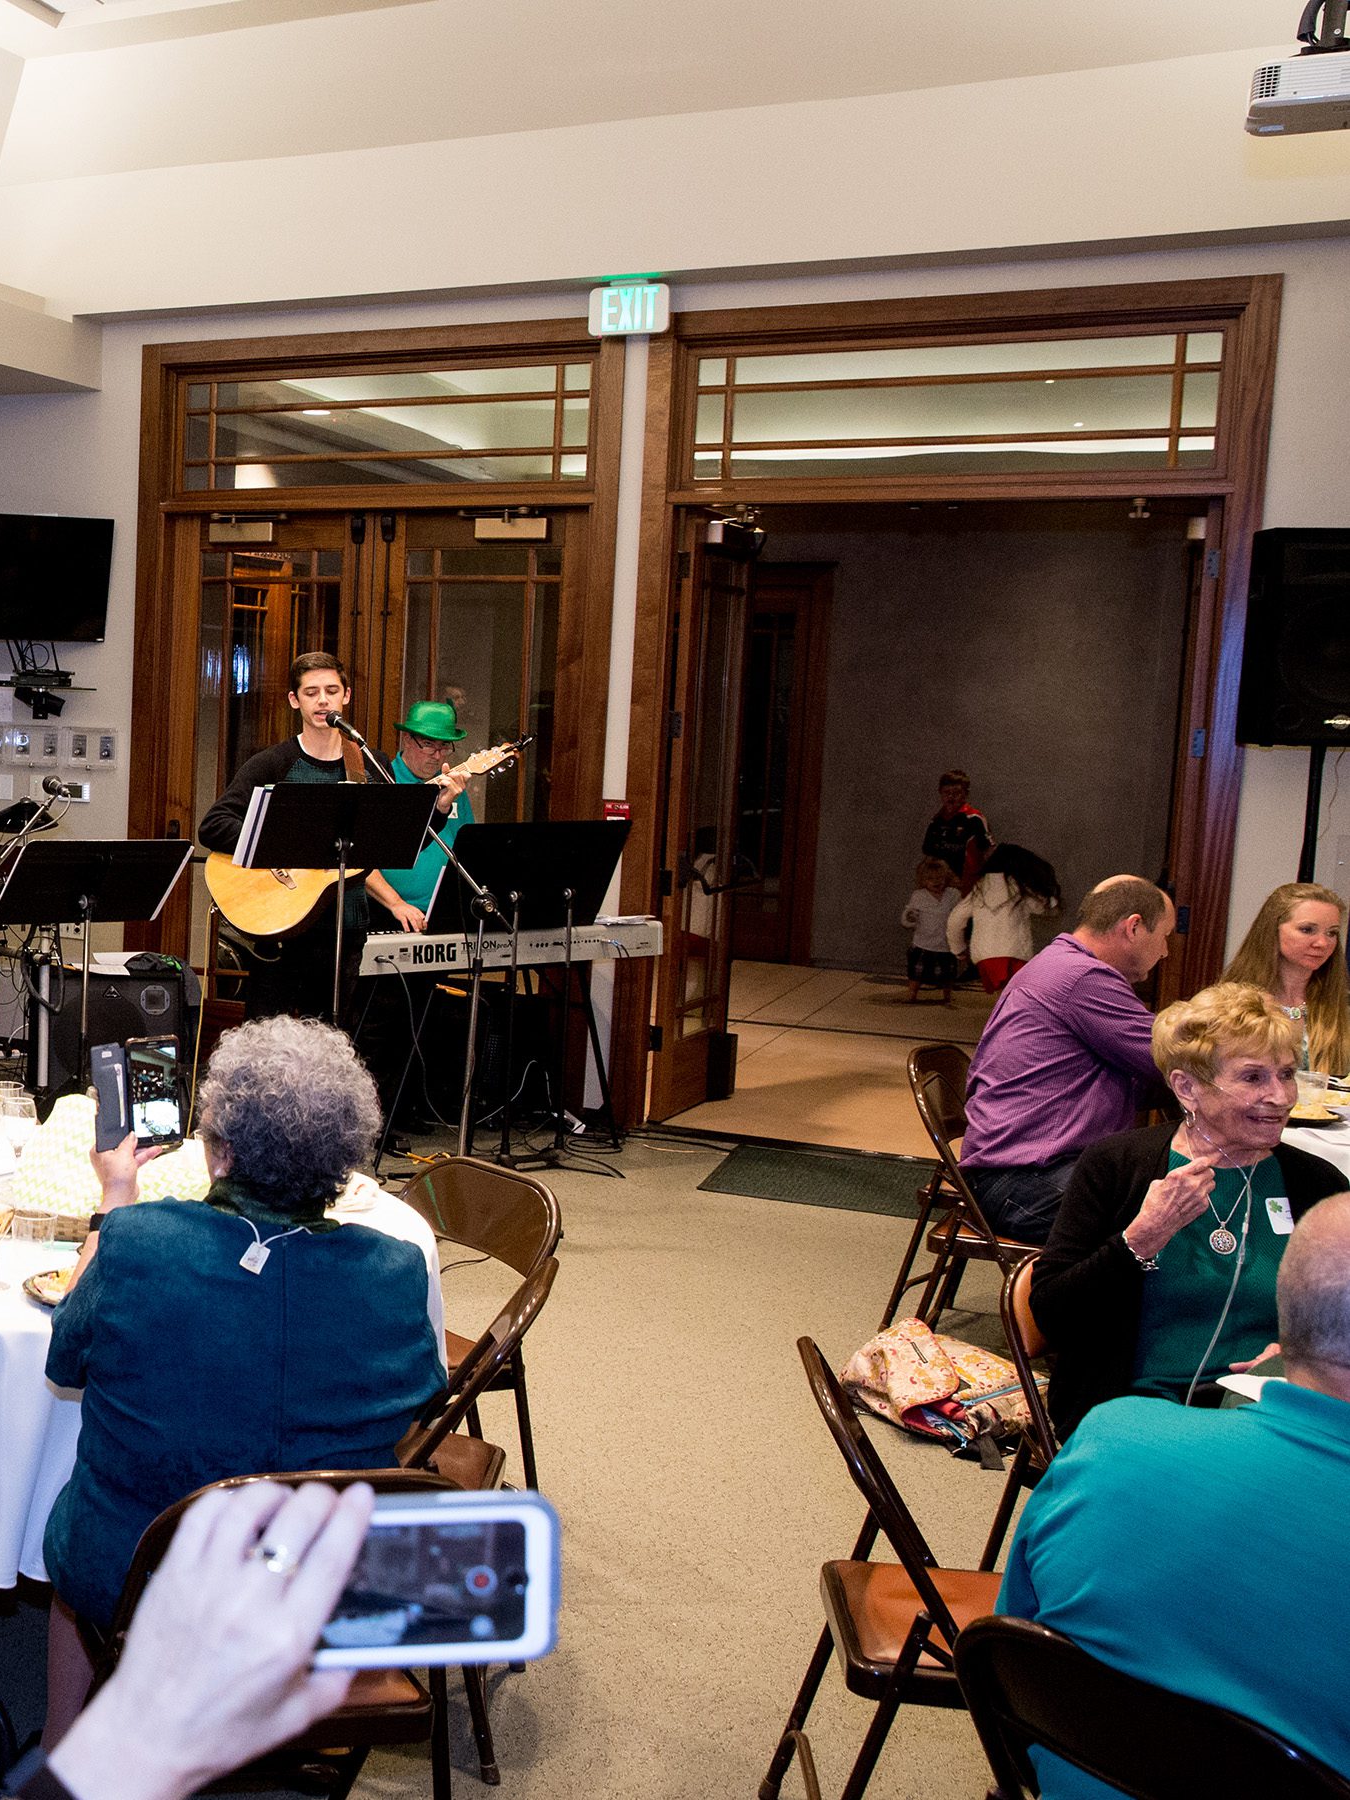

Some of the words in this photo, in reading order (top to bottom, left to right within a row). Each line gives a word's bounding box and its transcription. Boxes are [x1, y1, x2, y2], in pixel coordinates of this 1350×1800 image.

[601, 285, 659, 332] EXIT
[413, 943, 456, 964] KORG
[461, 940, 496, 951] TRION
